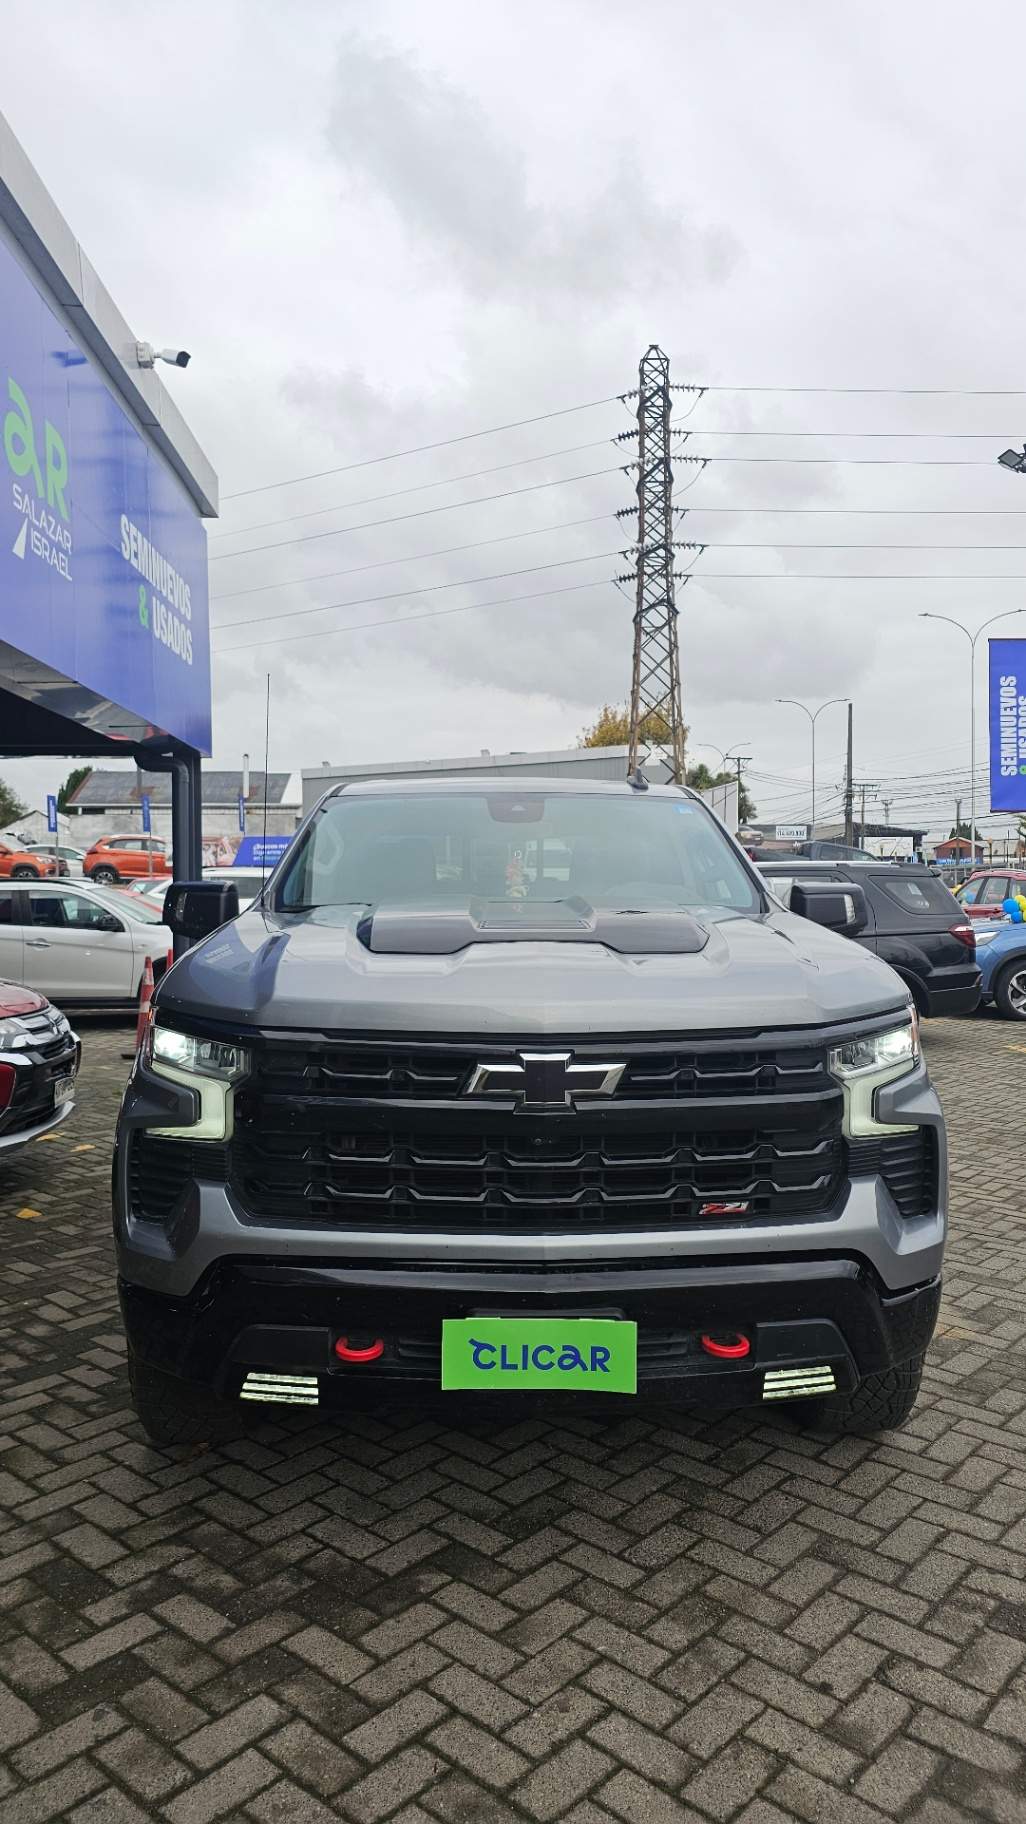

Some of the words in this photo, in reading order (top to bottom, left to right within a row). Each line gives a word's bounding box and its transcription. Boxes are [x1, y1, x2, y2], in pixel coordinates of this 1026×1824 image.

[12, 483, 72, 555] SALAZAR
[31, 527, 73, 581] ISRAEL
[120, 514, 192, 621] SEMINUEVOS
[138, 584, 149, 629] &
[152, 596, 193, 665] USADOS
[1000, 675, 1017, 777] SEMINUEVOS
